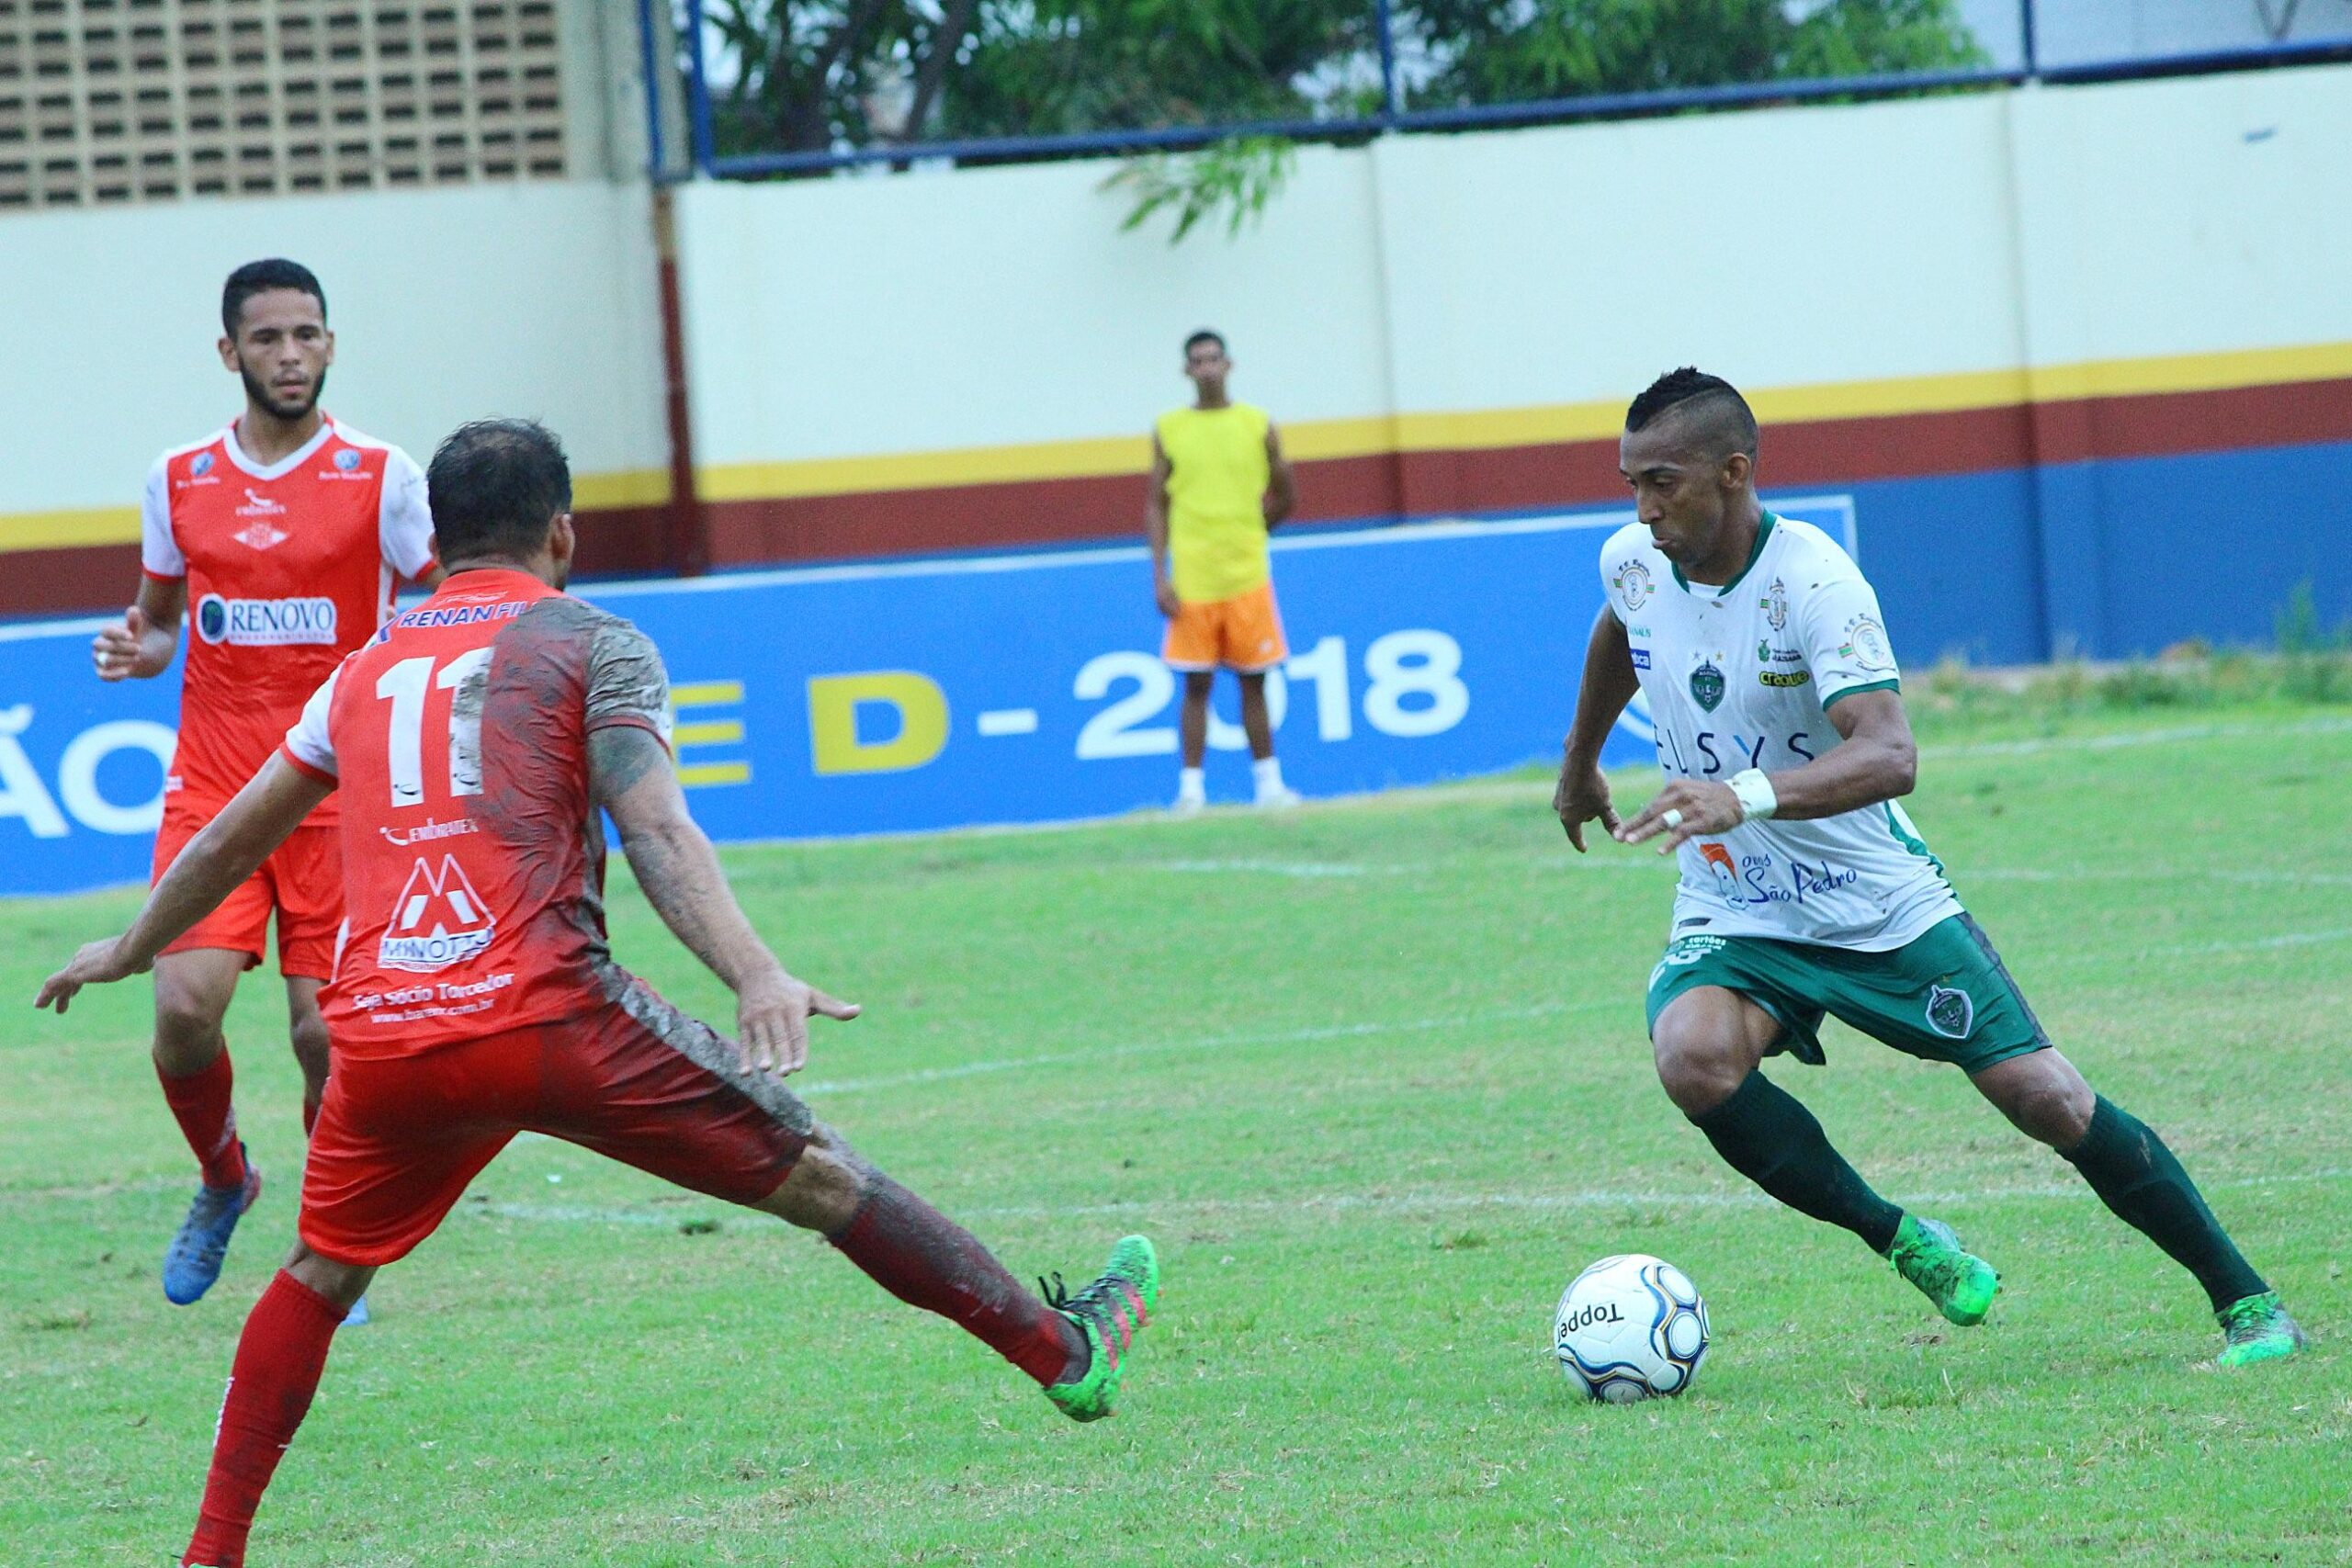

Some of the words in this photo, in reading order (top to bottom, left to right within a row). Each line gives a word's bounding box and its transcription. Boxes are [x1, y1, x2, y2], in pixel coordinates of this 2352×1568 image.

[232, 602, 332, 632] RENOVO
[376, 646, 496, 808] 11
[0, 703, 178, 839] ÃO
[805, 671, 951, 776] D
[1745, 866, 1791, 903] São
[1791, 861, 1857, 904] Pedro
[1557, 1303, 1624, 1343] Topper
